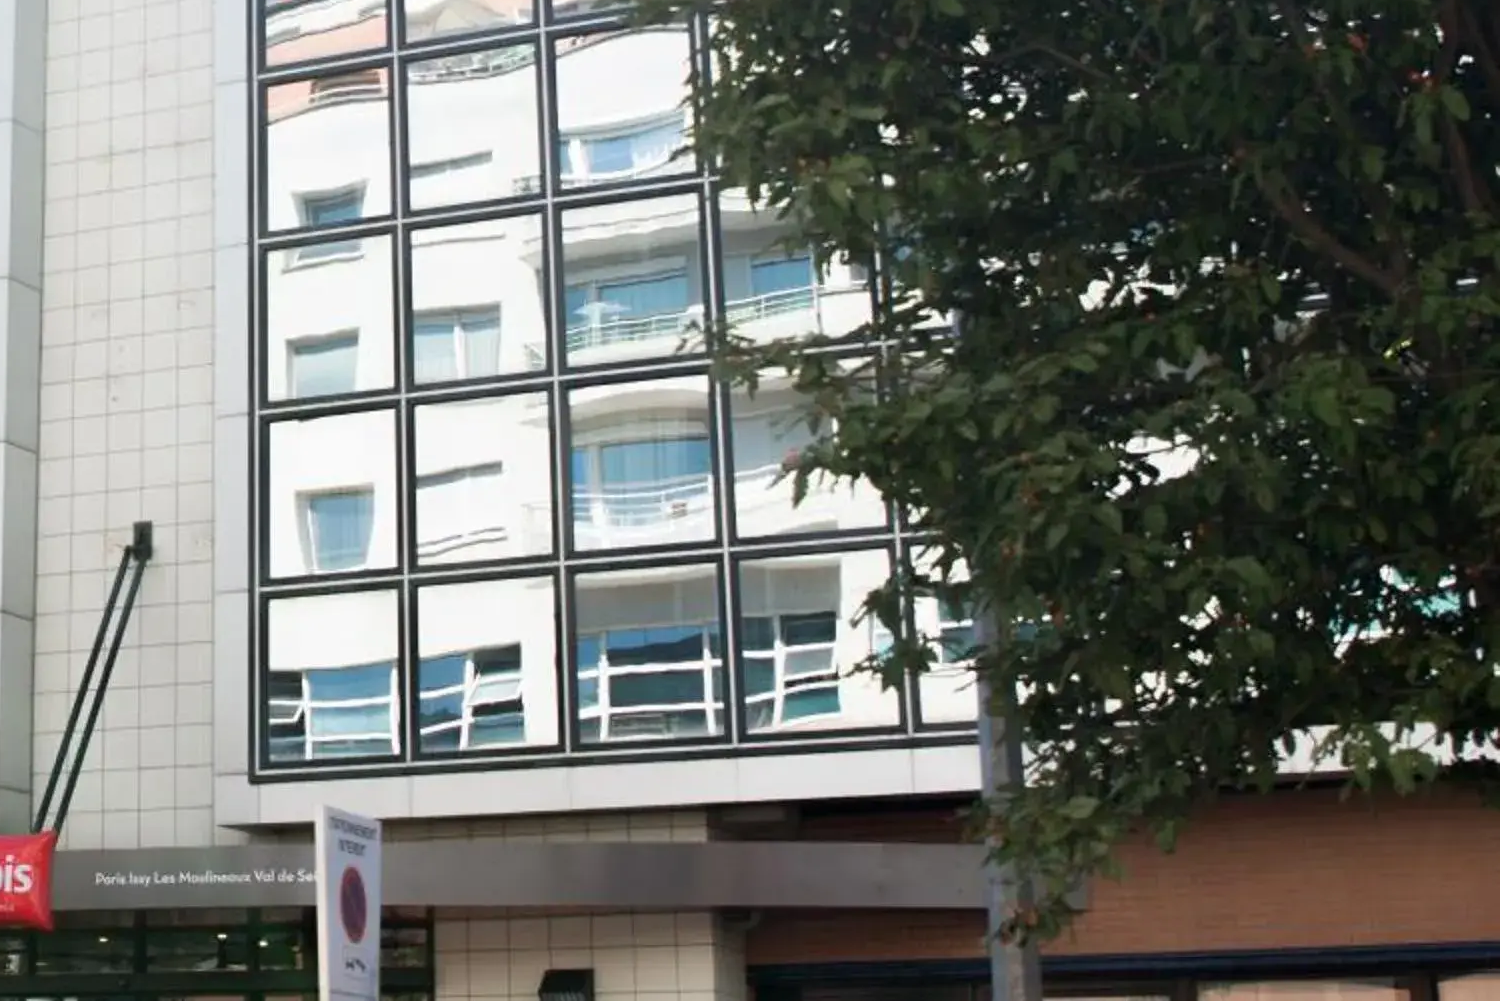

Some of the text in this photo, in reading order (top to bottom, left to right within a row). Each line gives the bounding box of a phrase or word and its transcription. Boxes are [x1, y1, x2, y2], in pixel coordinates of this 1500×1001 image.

[94, 871, 126, 886] Paris
[153, 870, 176, 885] Les
[179, 869, 251, 884] Moulineaux
[253, 869, 275, 883] Val
[277, 867, 295, 883] de
